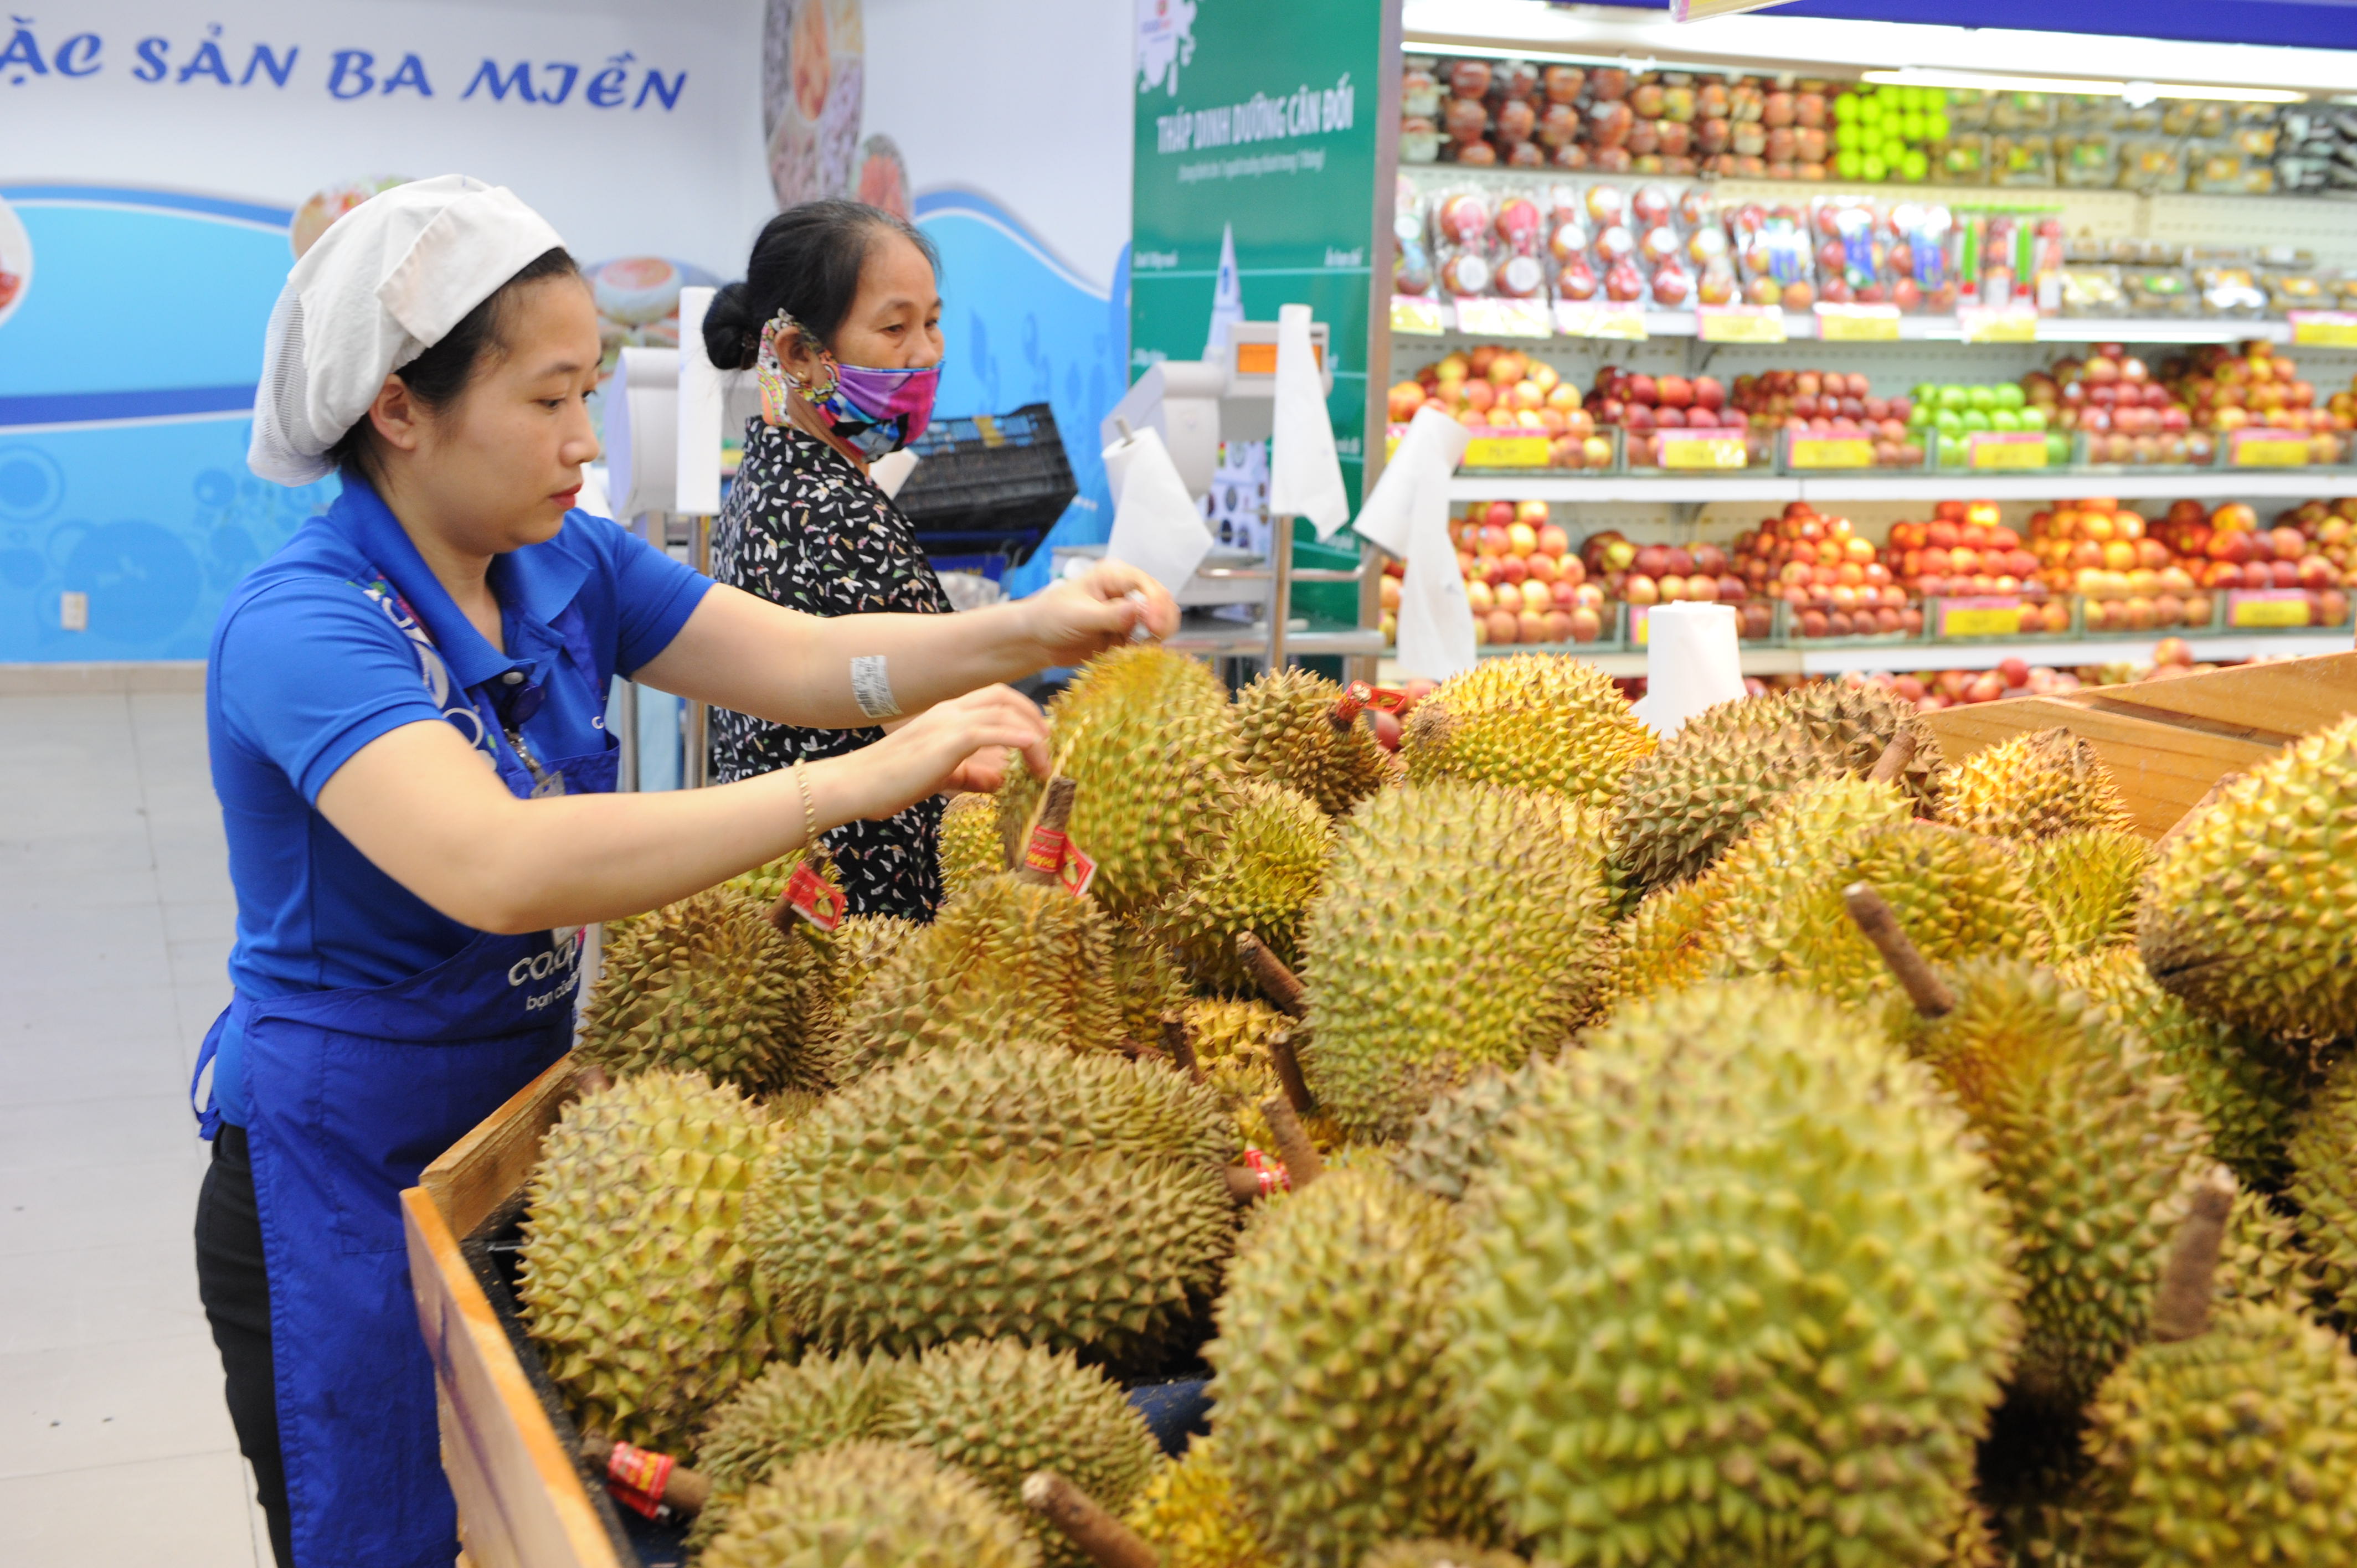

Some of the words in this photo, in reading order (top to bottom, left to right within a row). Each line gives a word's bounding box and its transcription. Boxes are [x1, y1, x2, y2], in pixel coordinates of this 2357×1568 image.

[132, 23, 300, 87] SẢN
[327, 49, 434, 100] BA
[460, 50, 688, 111] MIỀN
